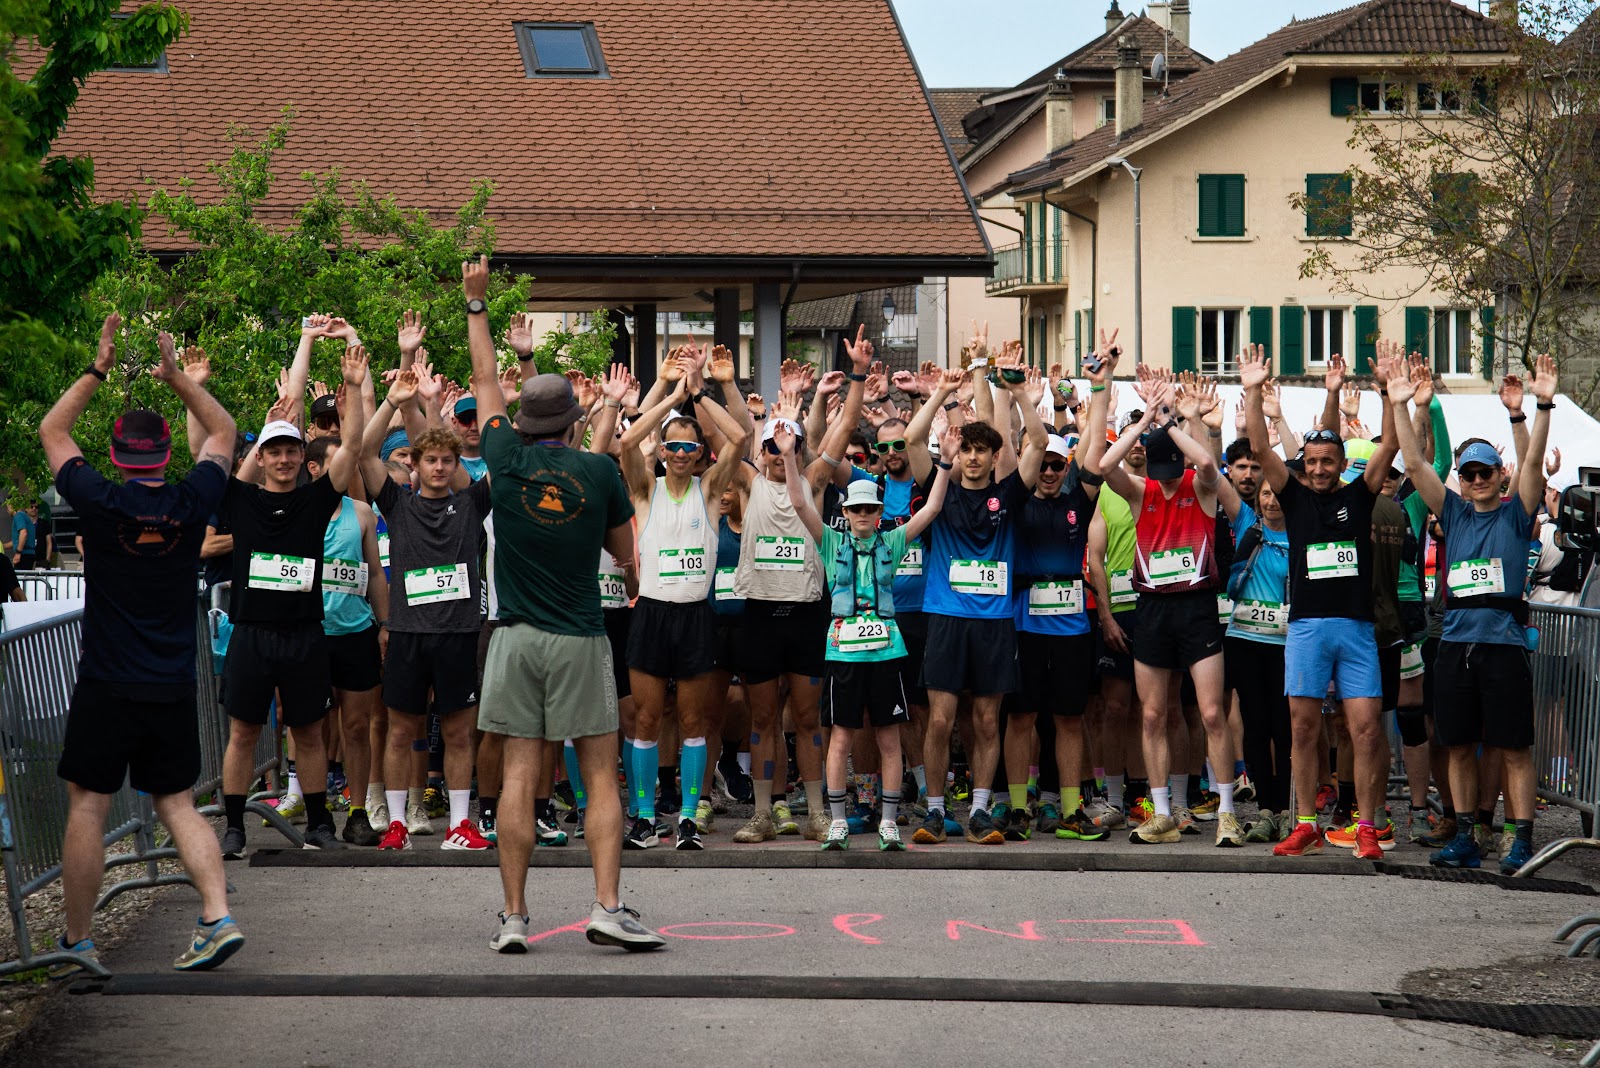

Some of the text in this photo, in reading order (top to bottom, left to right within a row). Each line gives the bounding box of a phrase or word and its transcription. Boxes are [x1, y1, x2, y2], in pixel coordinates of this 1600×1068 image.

[775, 545, 798, 558] 231
[1337, 550, 1354, 563] 80
[679, 557, 703, 570] 103
[1182, 556, 1191, 568] 6
[280, 564, 298, 578] 56
[333, 567, 356, 582] 193
[979, 569, 995, 582] 18
[1471, 568, 1488, 581] 89
[437, 574, 453, 588] 57
[604, 583, 624, 596] 104
[1057, 589, 1071, 602] 17
[1252, 608, 1275, 622] 215
[858, 624, 883, 638] 223
